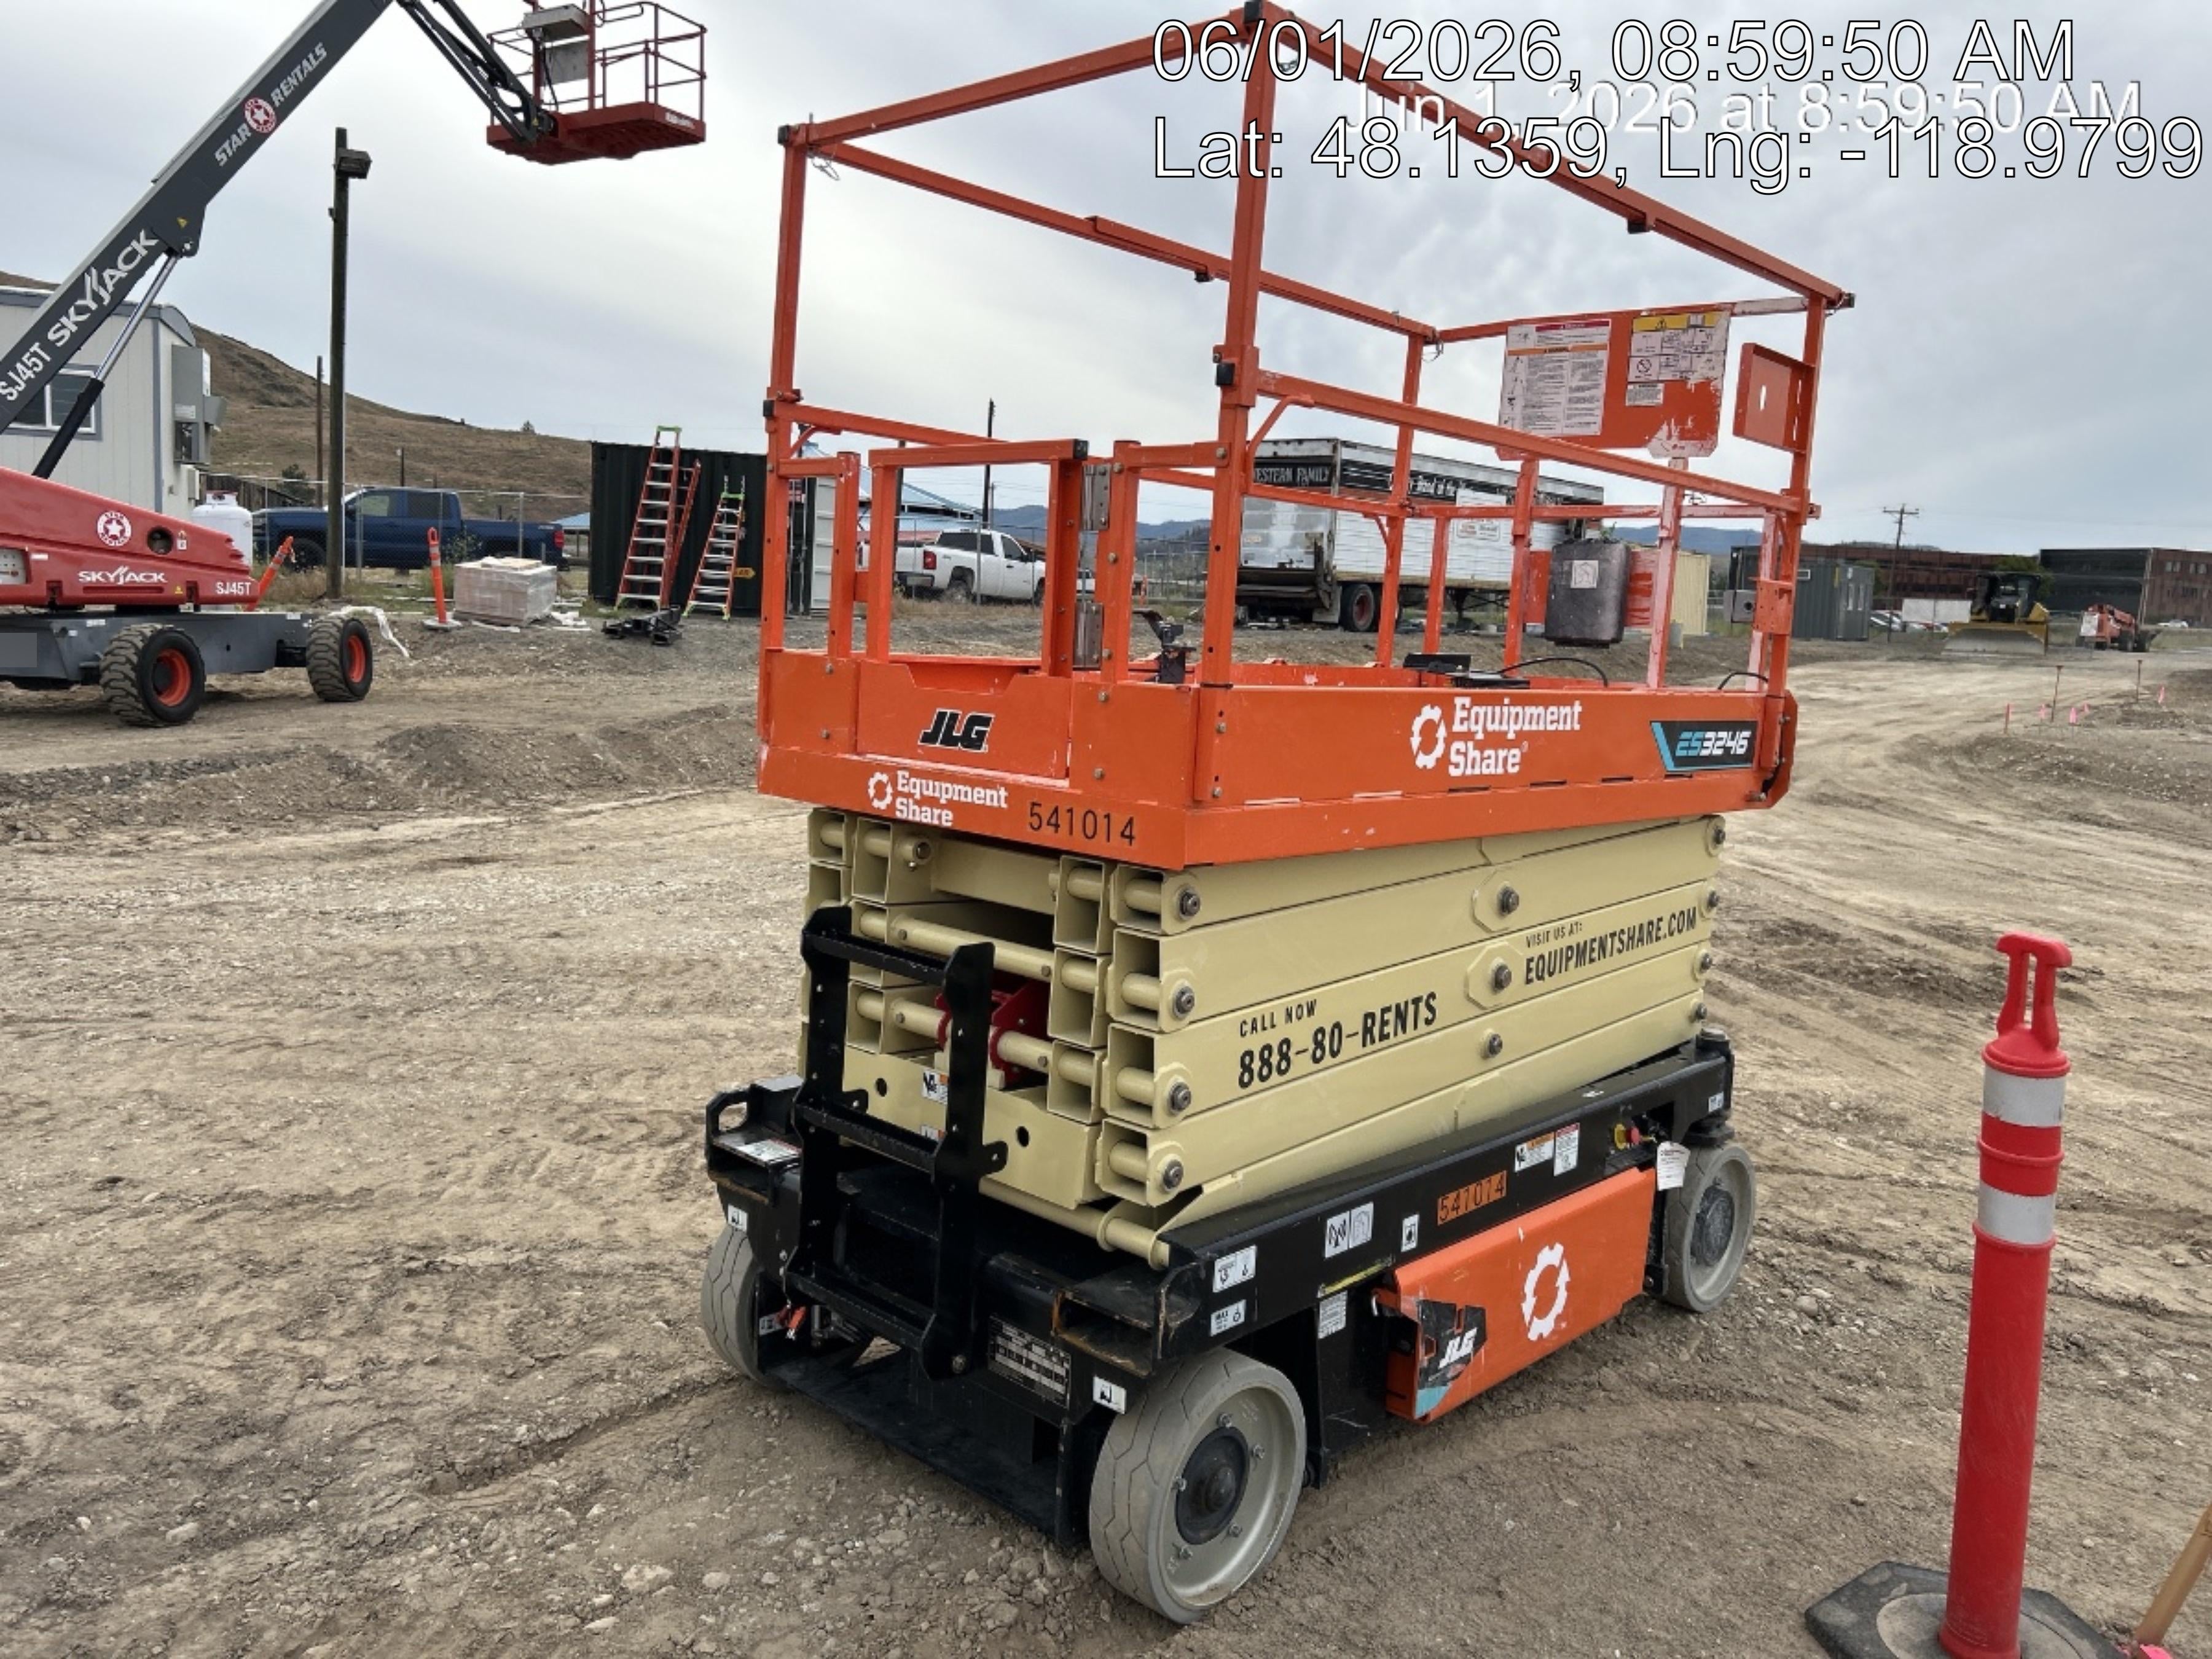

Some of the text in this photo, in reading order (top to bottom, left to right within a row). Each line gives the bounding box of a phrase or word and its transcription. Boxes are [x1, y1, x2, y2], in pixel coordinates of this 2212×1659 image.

[215, 42, 327, 167] STAR RENTALS
[0, 229, 159, 401] SJ45T SKYJACK
[78, 565, 168, 584] SKYJACK
[216, 581, 252, 595] SJ45T
[918, 708, 995, 753] JLG
[1451, 696, 1583, 740] Equipment
[1448, 740, 1522, 777] Share
[1675, 731, 1752, 756] ES3246
[896, 769, 1008, 809] Equipment
[895, 798, 953, 827] Share
[1028, 801, 1136, 847] 541014
[1525, 906, 1696, 985] EQUIPMENTSHARE.COM
[1526, 921, 1583, 948] VISIT US AT:
[1239, 998, 1317, 1038] CALL NOW
[1238, 991, 1437, 1089] 888-80-RENTS
[1440, 1171, 1505, 1222] 541014
[1438, 1327, 1477, 1368] JLG
